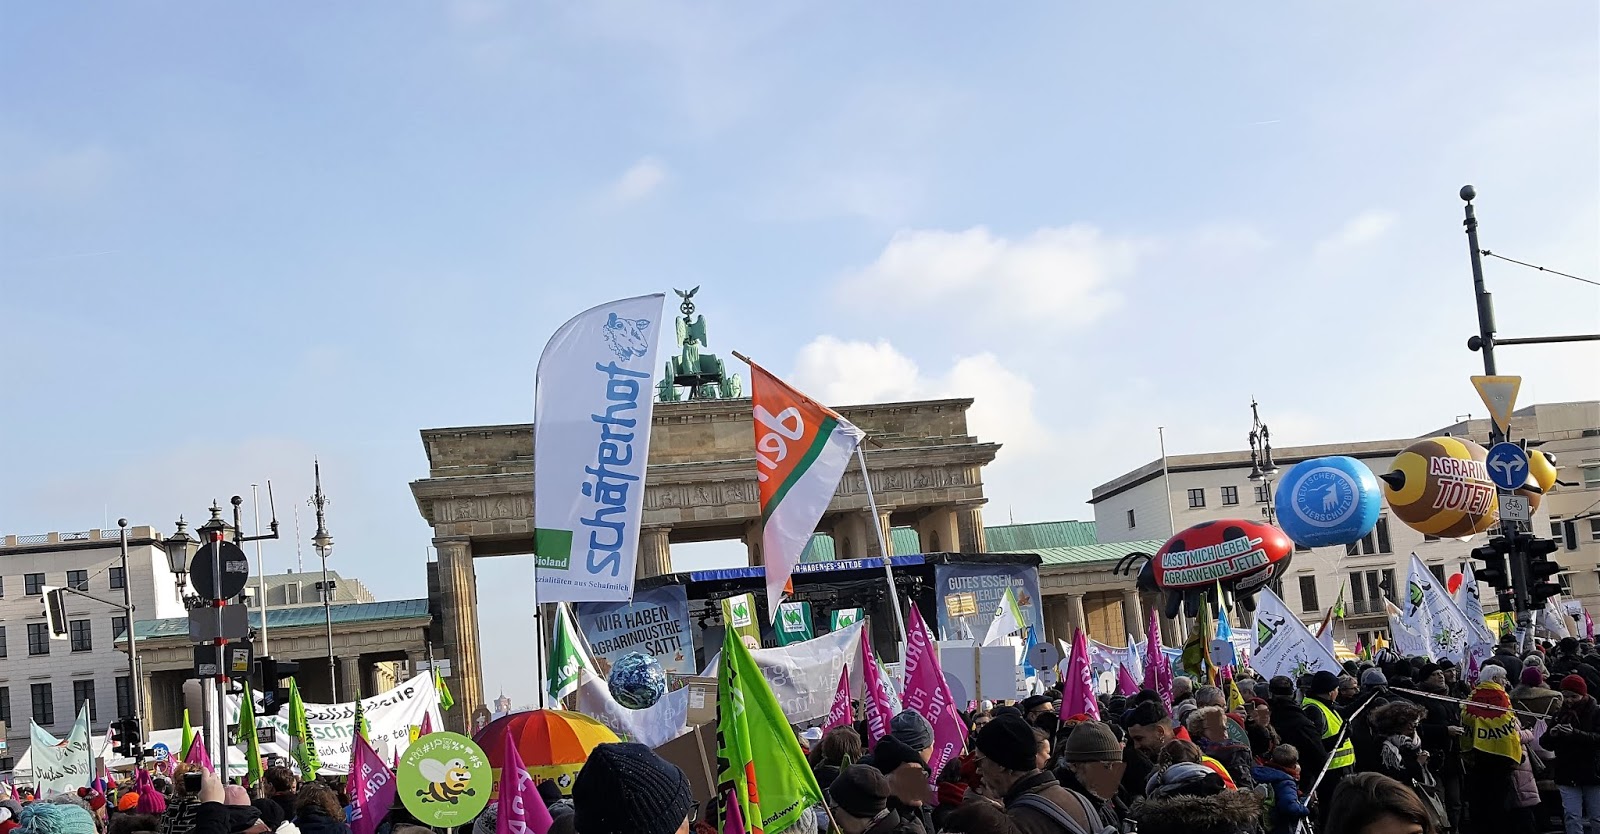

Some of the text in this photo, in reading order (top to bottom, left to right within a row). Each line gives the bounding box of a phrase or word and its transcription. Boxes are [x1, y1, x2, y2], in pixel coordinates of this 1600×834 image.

[580, 360, 651, 577] schäferhof
[1298, 472, 1336, 503] DEUTSCHER
[1302, 479, 1352, 521] TIERSCHUTZBUND
[1434, 476, 1495, 515] TÖTET!
[1162, 553, 1188, 568] LASST
[1189, 547, 1215, 564] MICH
[1217, 540, 1251, 558] LEBEN
[1164, 561, 1233, 585] AGRARWENDE
[1233, 550, 1269, 573] JETZT!
[588, 581, 629, 592] Schafmilch
[948, 574, 1024, 591] GUTES ESSEN UND
[594, 605, 670, 633] WIR HABEN
[591, 619, 683, 657] AGRARINDUSTRIE
[645, 635, 683, 657] SATT!
[1477, 719, 1516, 740] DANK
[318, 745, 339, 757] sich
